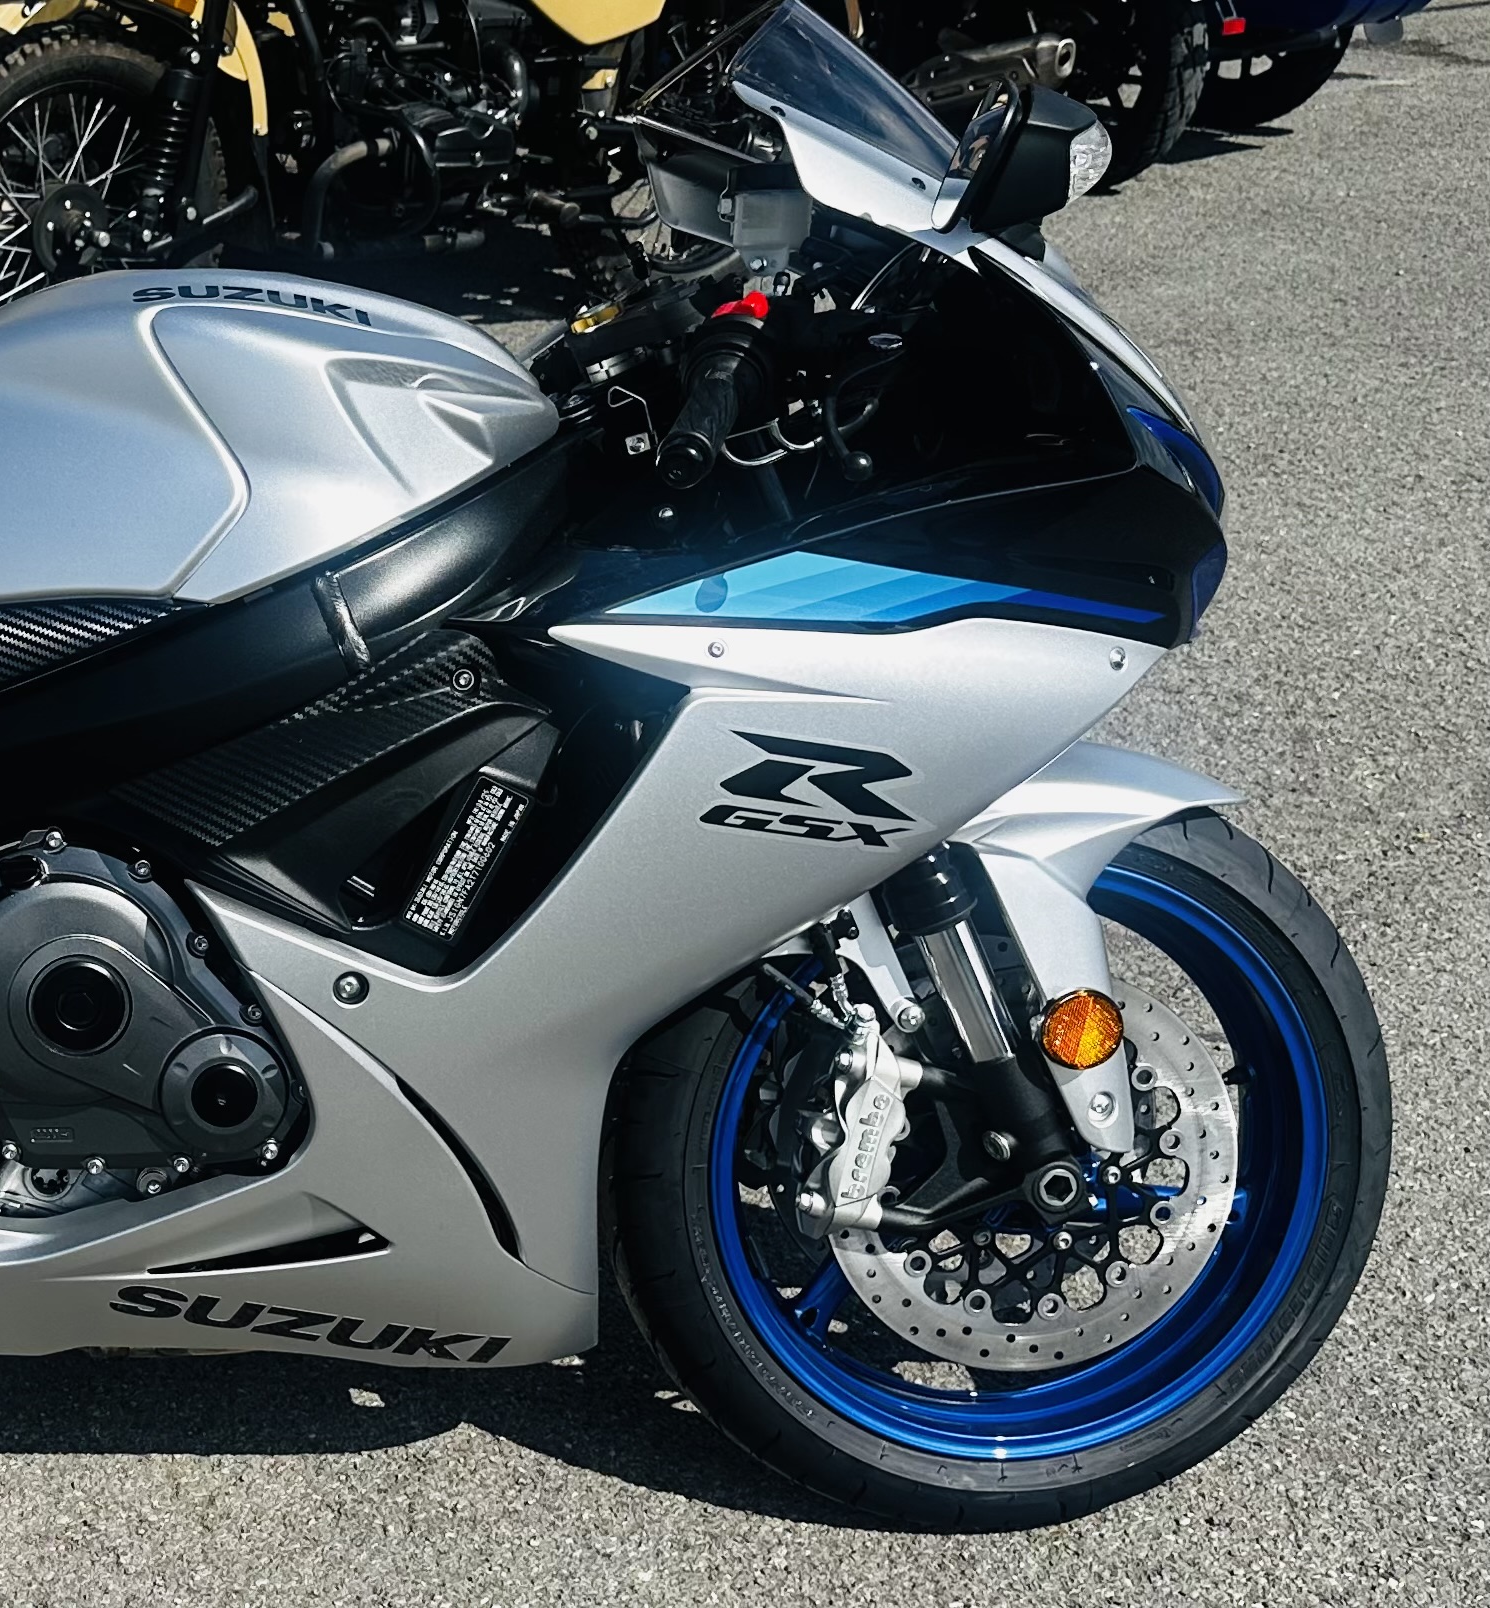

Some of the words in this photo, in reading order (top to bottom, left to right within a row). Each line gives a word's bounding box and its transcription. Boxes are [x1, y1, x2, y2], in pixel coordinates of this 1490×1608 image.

[132, 285, 373, 327] SUZUKI
[719, 729, 918, 823] R
[699, 804, 914, 848] GSX
[841, 1093, 891, 1199] brembo
[109, 1285, 512, 1363] SUZUKI
